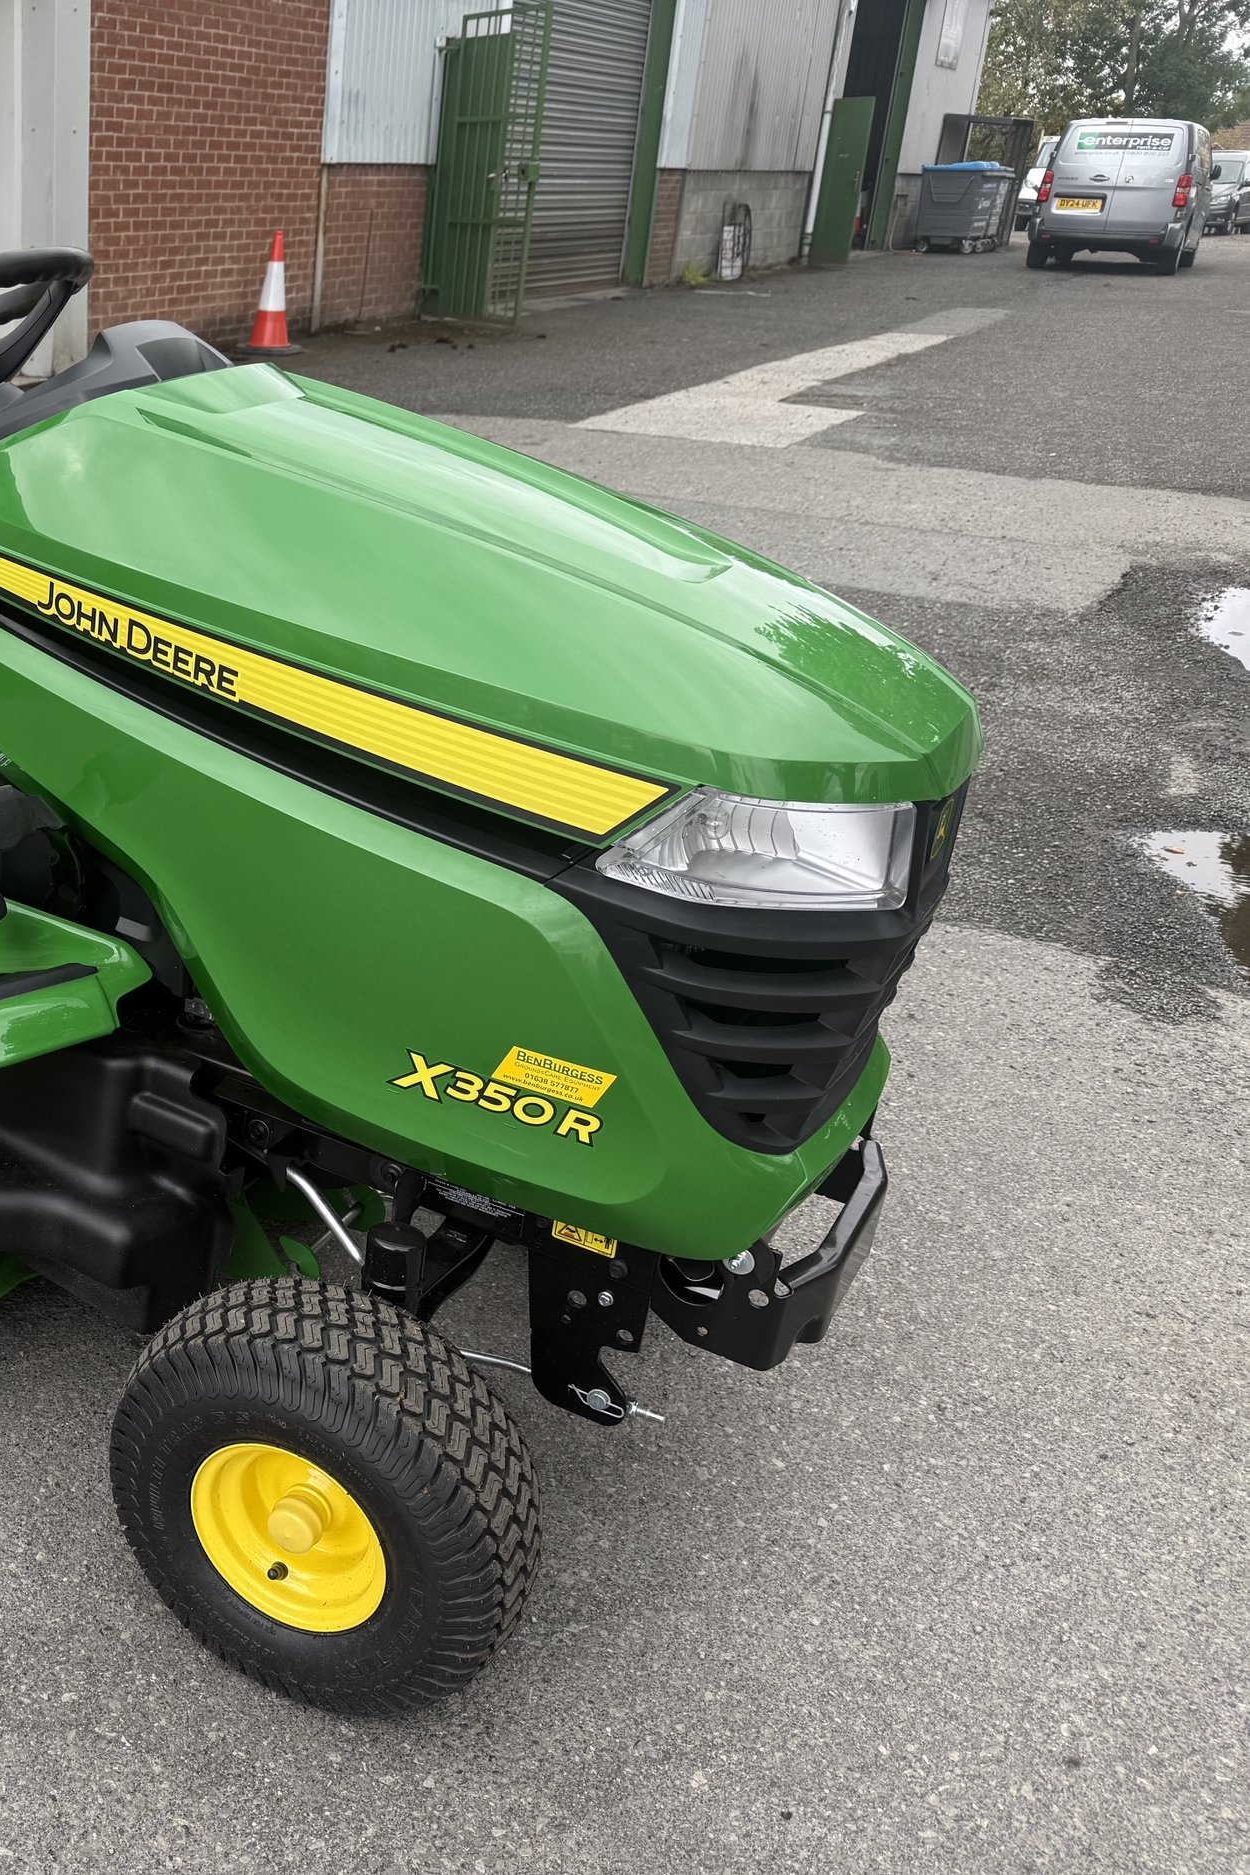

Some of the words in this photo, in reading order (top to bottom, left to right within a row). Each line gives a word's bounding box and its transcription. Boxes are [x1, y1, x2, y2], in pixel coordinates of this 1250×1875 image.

[1081, 135, 1172, 148] enterprise
[1059, 199, 1080, 207] DY24
[1081, 200, 1098, 208] UFK
[37, 581, 120, 646] JOHN
[126, 618, 240, 699] DEERE
[502, 1073, 584, 1102] www.benburgess.co.uk
[524, 1072, 549, 1084] 01638
[549, 1080, 580, 1094] 577877
